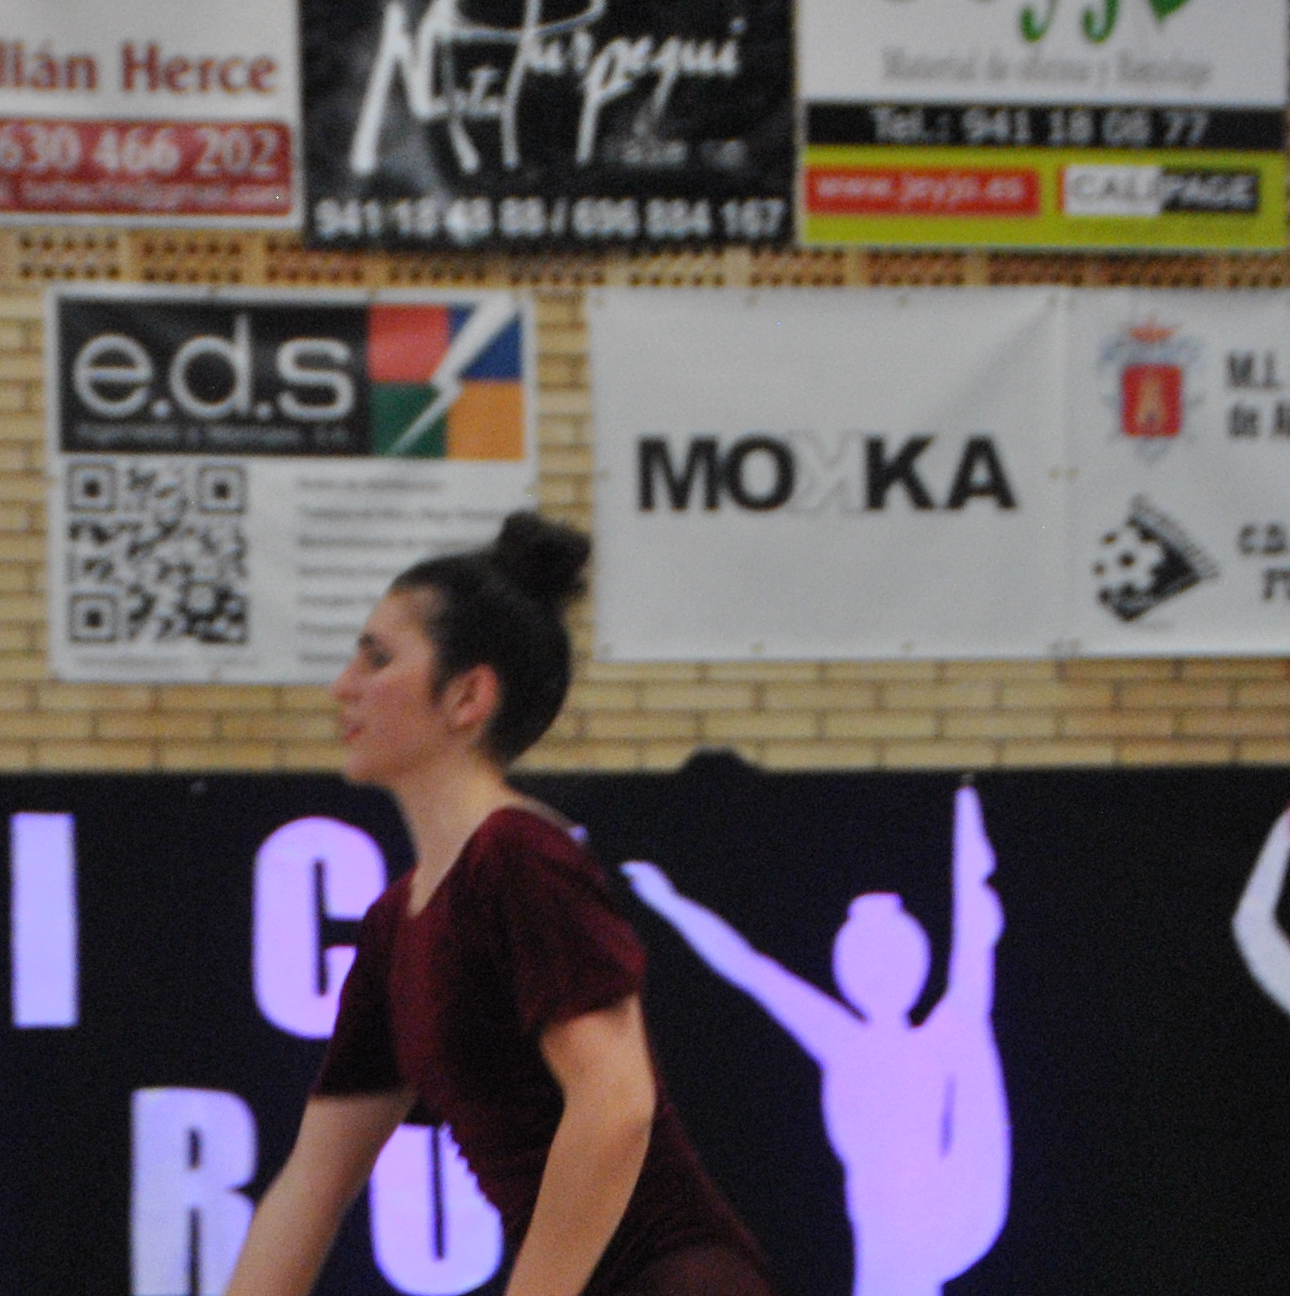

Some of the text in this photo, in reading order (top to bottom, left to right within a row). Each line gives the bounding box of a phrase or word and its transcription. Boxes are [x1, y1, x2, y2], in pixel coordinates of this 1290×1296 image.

[120, 41, 278, 94] Herce
[93, 125, 181, 174] 466
[194, 126, 278, 176] 202
[961, 109, 1032, 146] 941
[1163, 110, 1208, 147] 77
[71, 311, 357, 421] e.d.s
[1227, 403, 1260, 439] de
